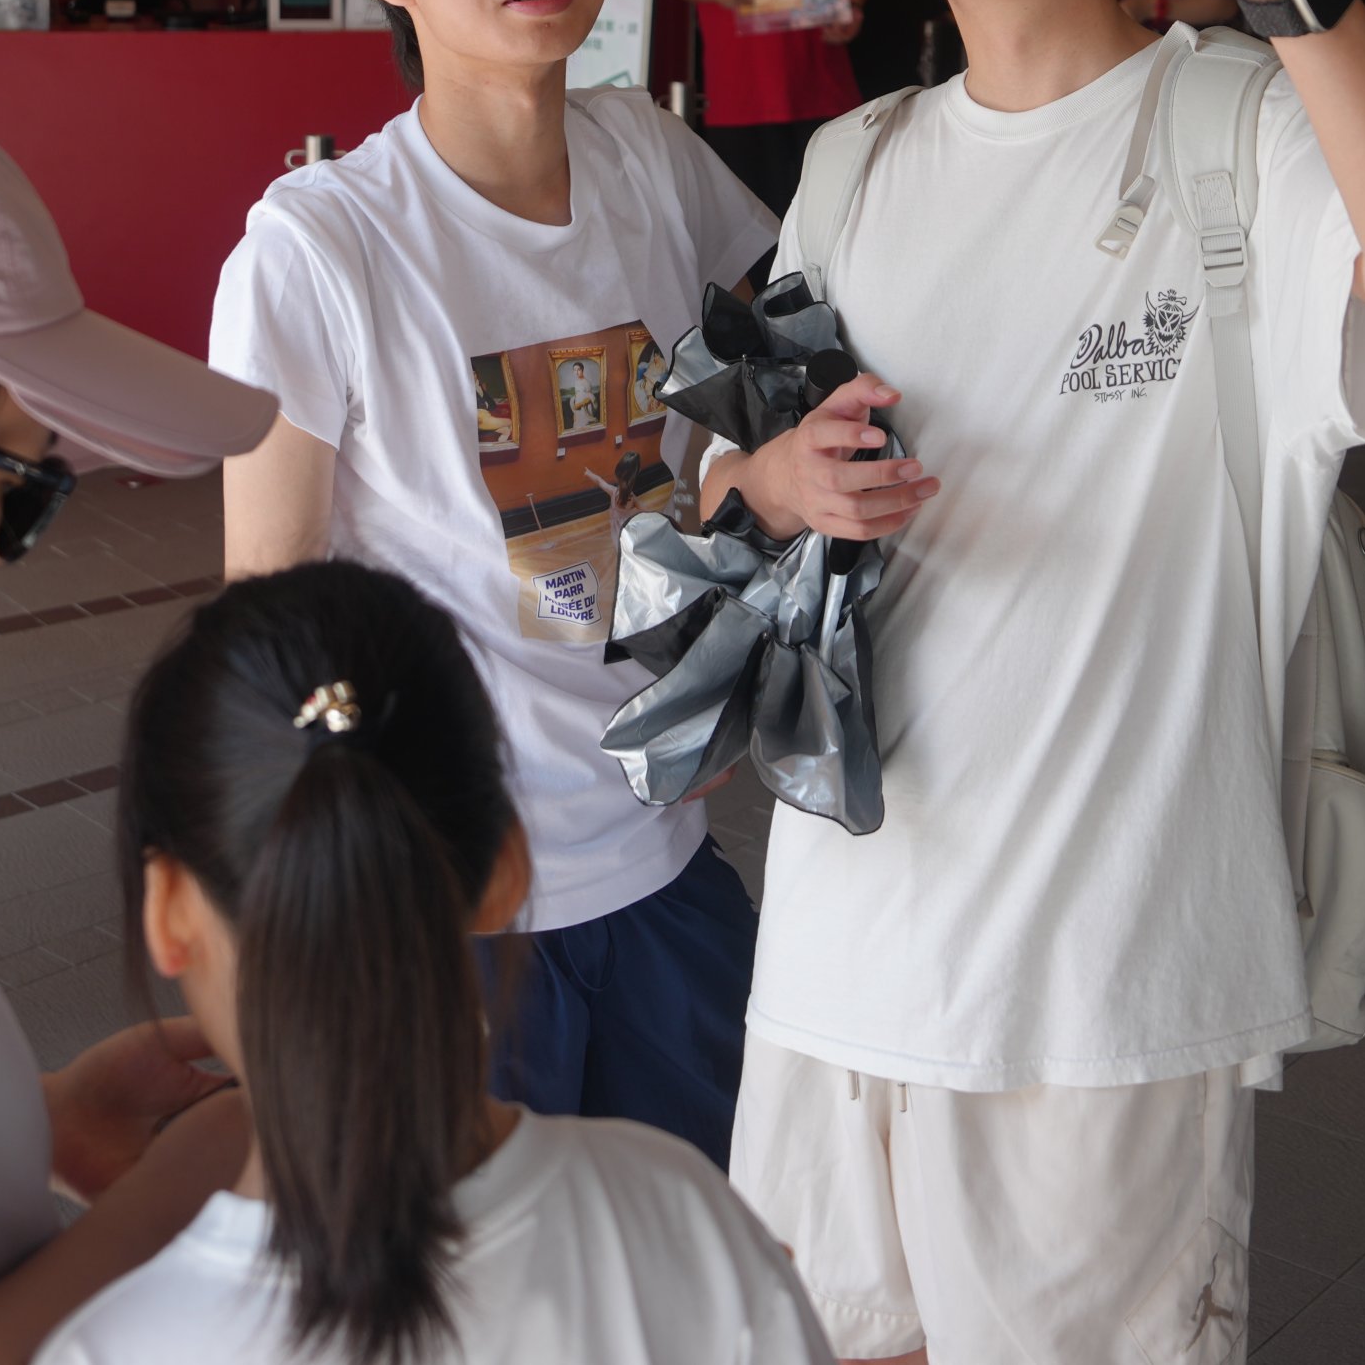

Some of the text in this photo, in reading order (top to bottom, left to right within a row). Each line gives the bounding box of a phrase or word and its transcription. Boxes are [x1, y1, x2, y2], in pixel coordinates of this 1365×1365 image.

[1059, 357, 1182, 395] POOL SERVIC
[1131, 387, 1148, 400] INC.
[545, 568, 587, 590] MARTIN
[554, 583, 585, 599] PARR
[584, 593, 596, 609] DU
[550, 605, 594, 622] LOUVRE
